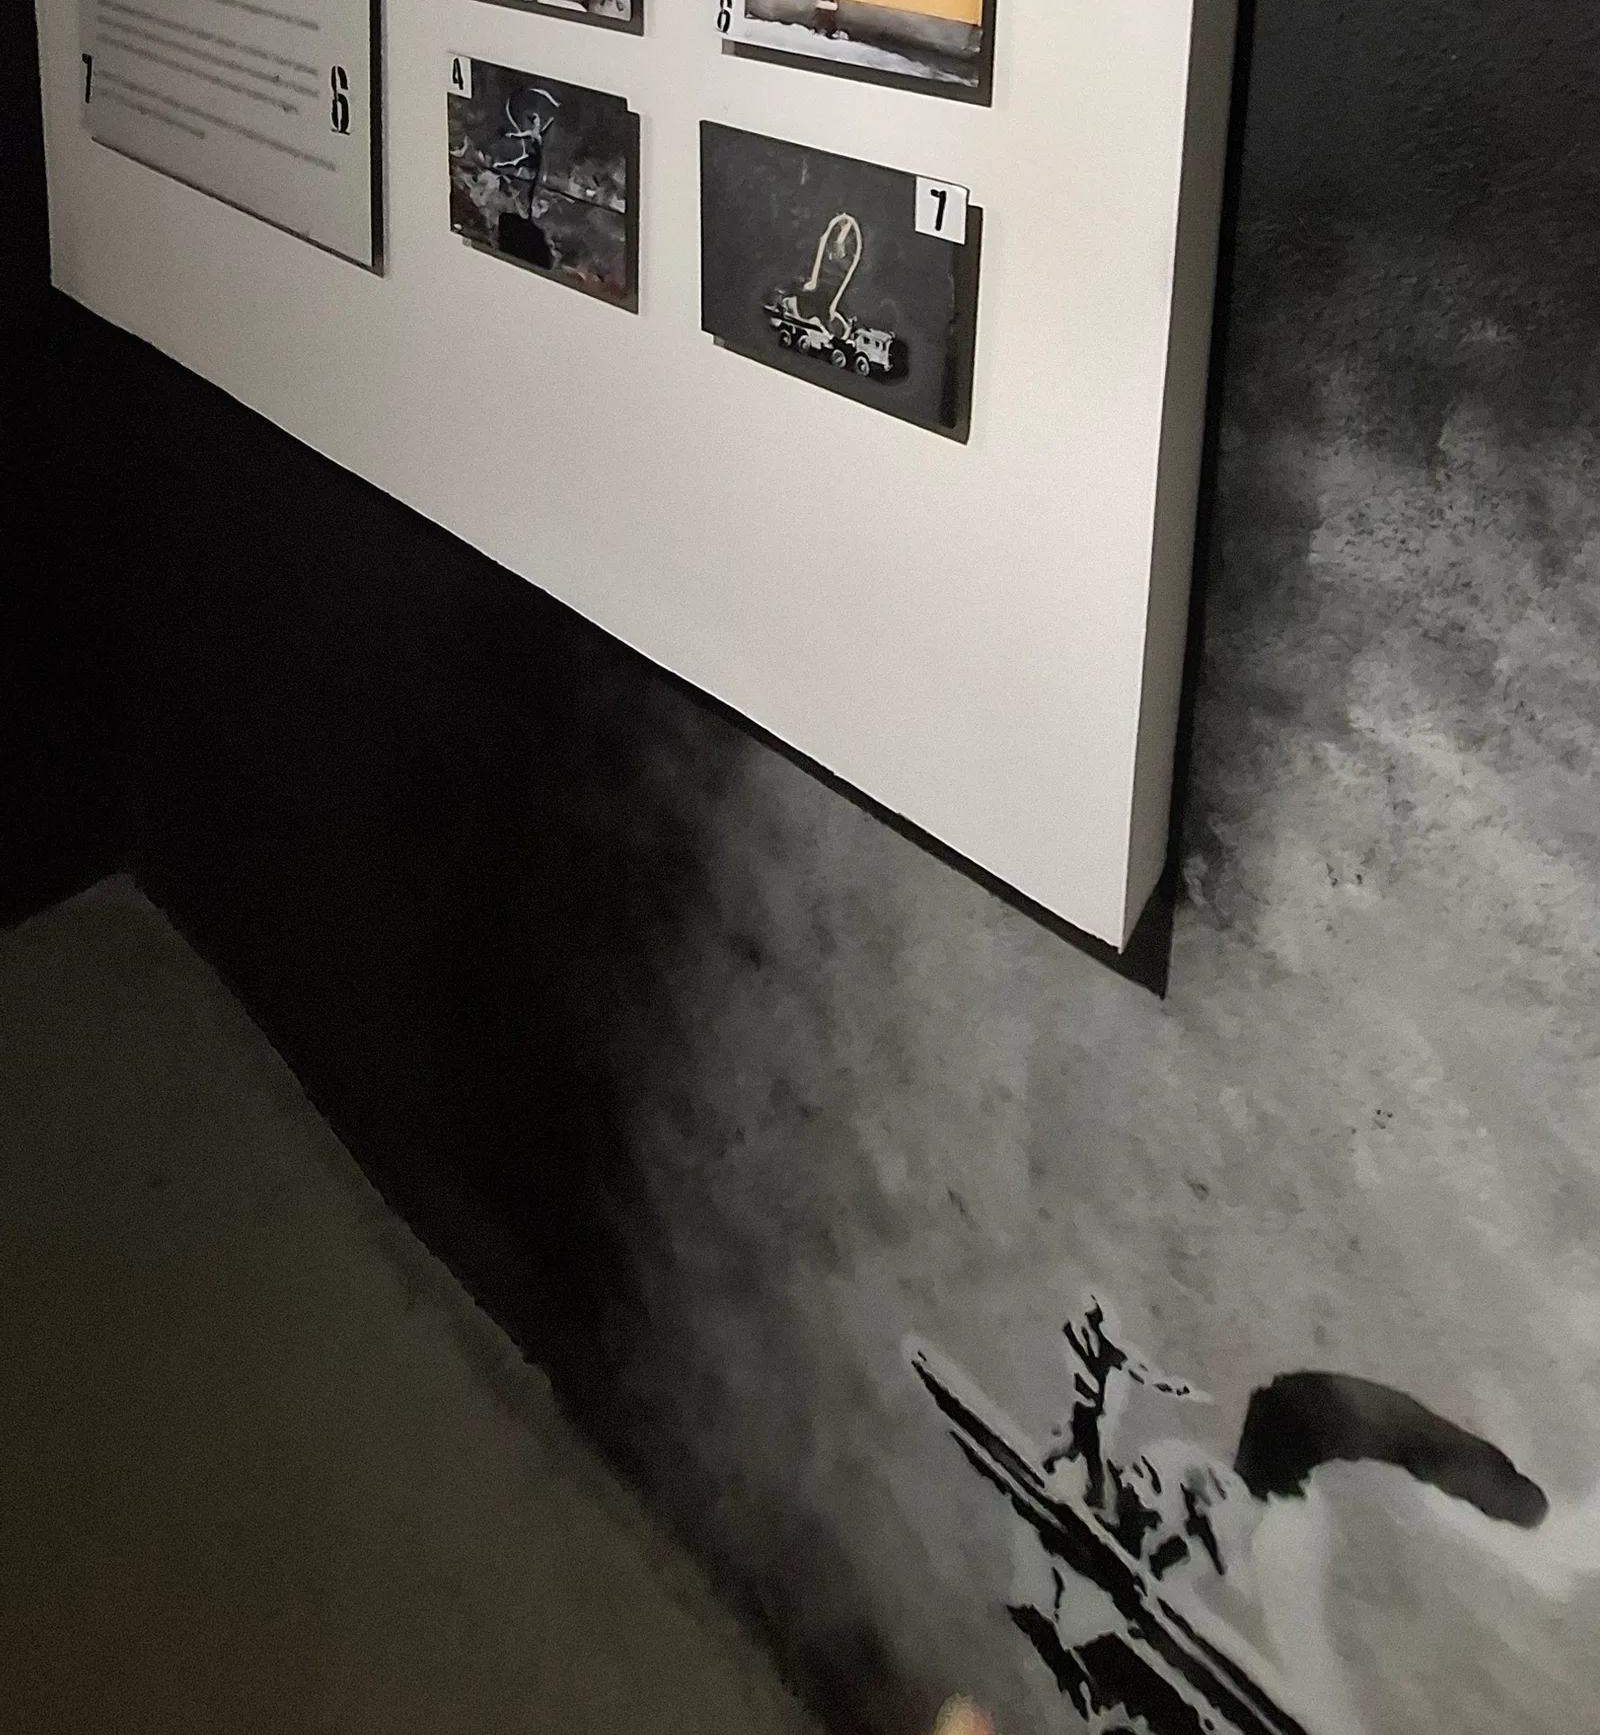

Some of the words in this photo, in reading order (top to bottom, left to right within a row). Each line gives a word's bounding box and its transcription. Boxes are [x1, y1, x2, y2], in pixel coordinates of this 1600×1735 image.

[81, 54, 95, 104] 7
[451, 57, 465, 91] 4
[330, 65, 352, 135] 6
[929, 188, 949, 233] 7
